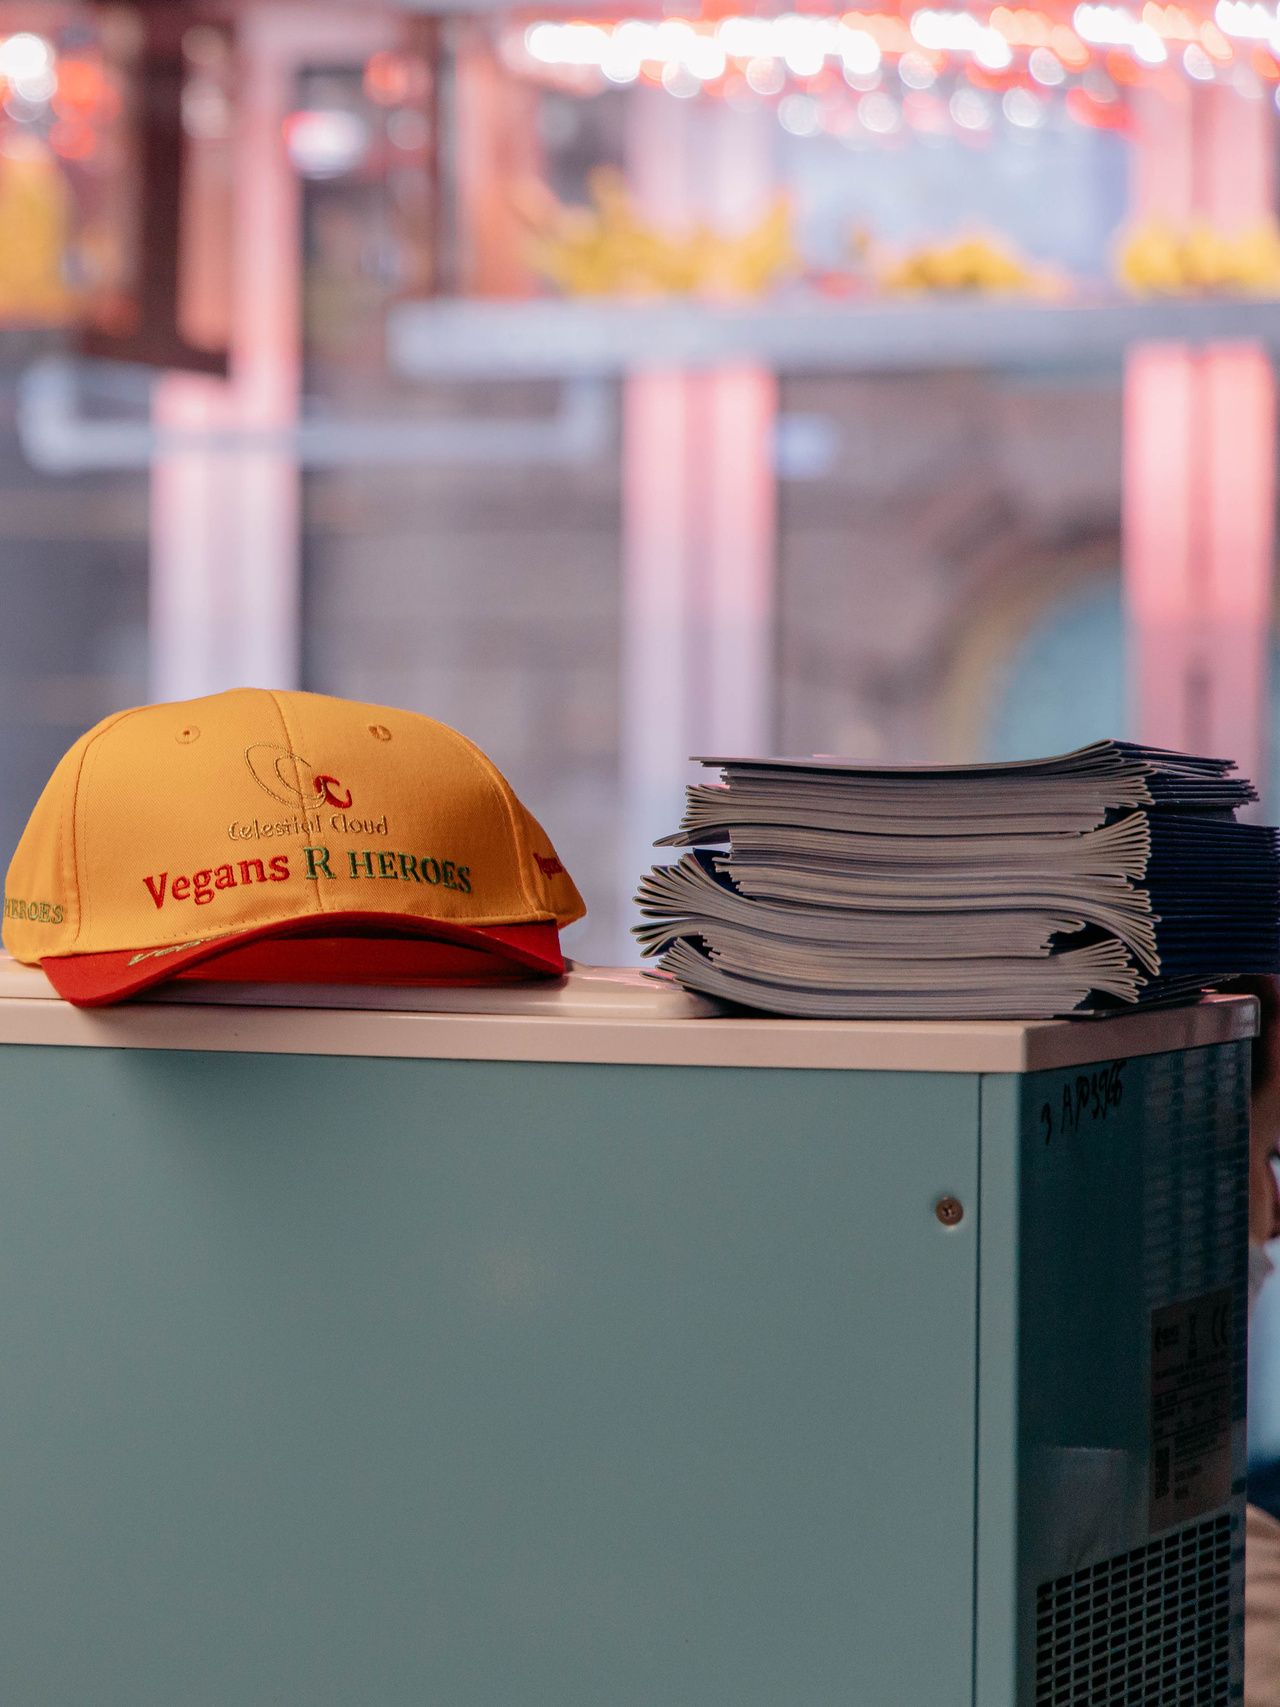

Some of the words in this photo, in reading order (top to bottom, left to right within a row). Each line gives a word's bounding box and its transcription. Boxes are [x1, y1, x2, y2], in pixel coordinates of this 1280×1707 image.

[227, 813, 322, 841] Celestial
[329, 813, 389, 837] Cloud
[142, 854, 291, 911] Vegans
[303, 846, 336, 880] R
[347, 850, 472, 894] HEROES
[4, 897, 64, 925] HEROES
